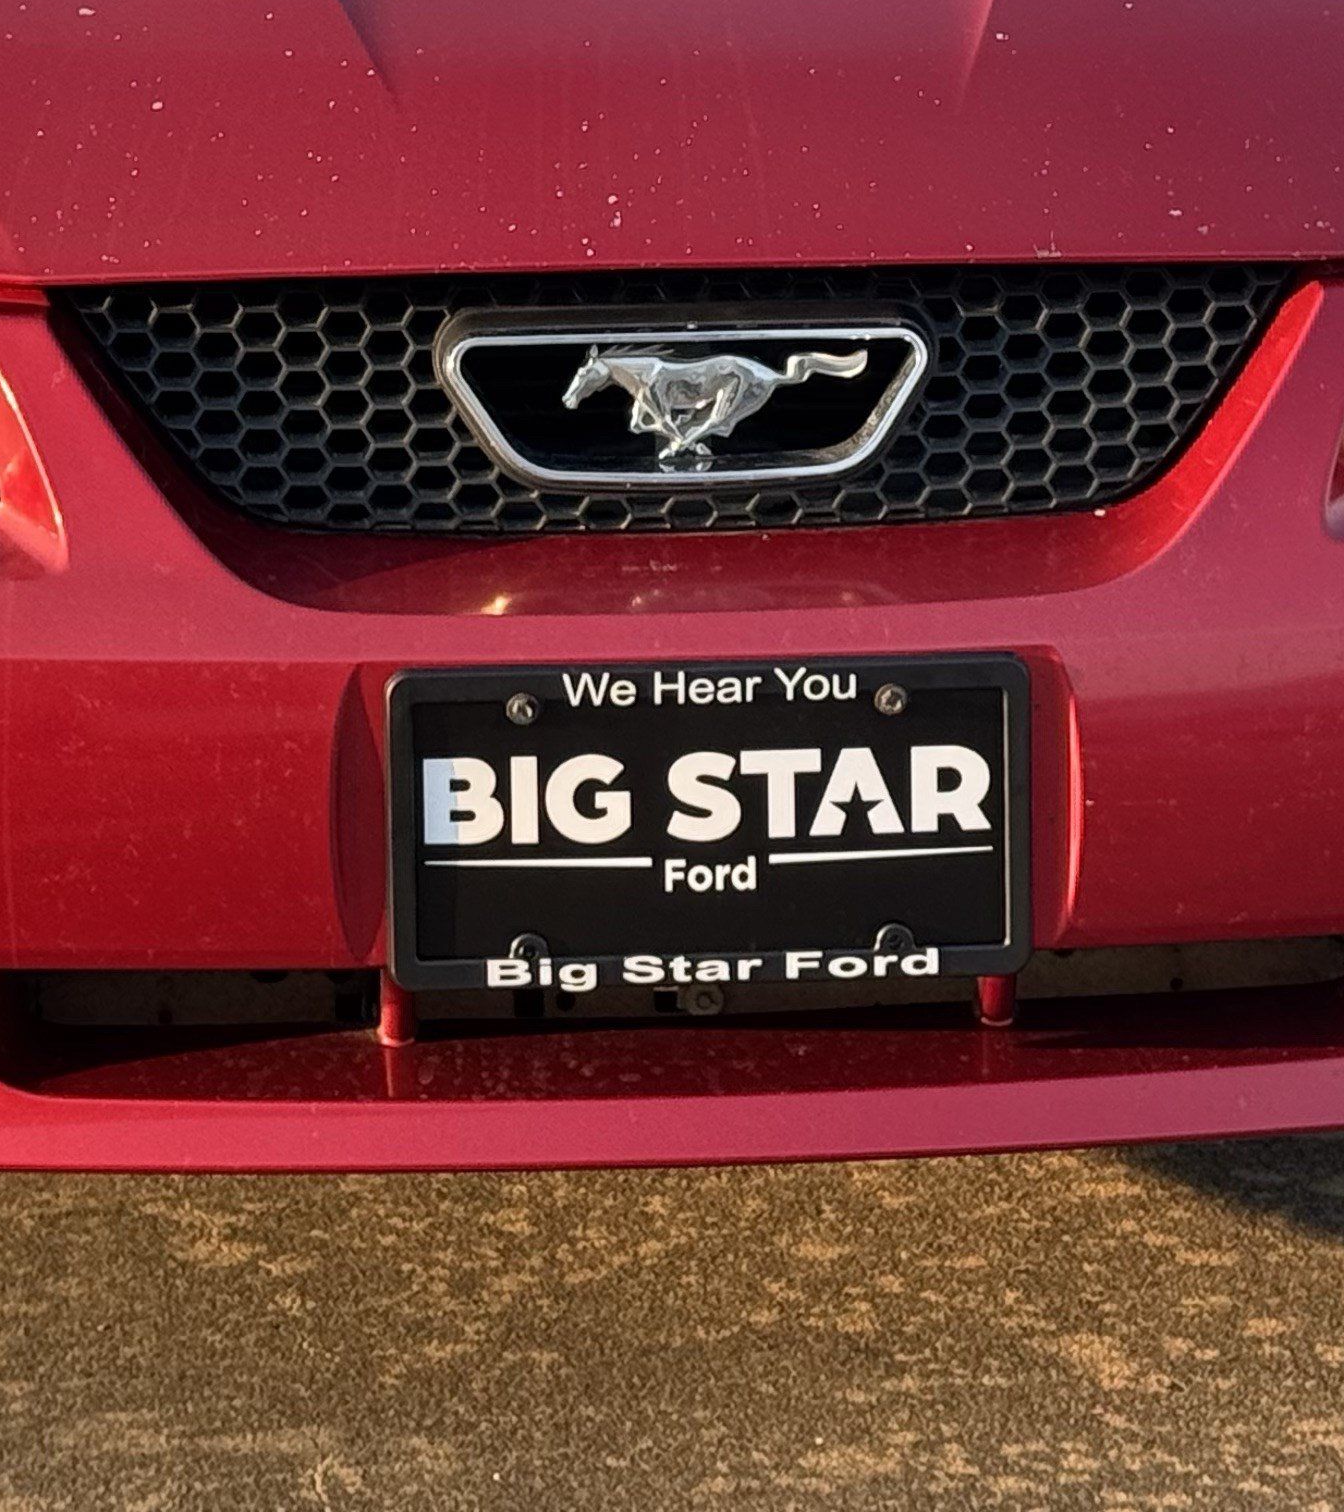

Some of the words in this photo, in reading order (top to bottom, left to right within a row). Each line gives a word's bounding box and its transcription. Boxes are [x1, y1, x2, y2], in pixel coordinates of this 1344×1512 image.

[562, 672, 637, 707] We
[654, 670, 762, 705] Hear
[774, 666, 857, 701] You
[423, 753, 631, 845] BIG
[666, 745, 991, 842] STAR
[664, 855, 757, 892] Ford
[486, 958, 597, 992] Big
[622, 955, 763, 984] Star
[785, 947, 939, 979] Ford
